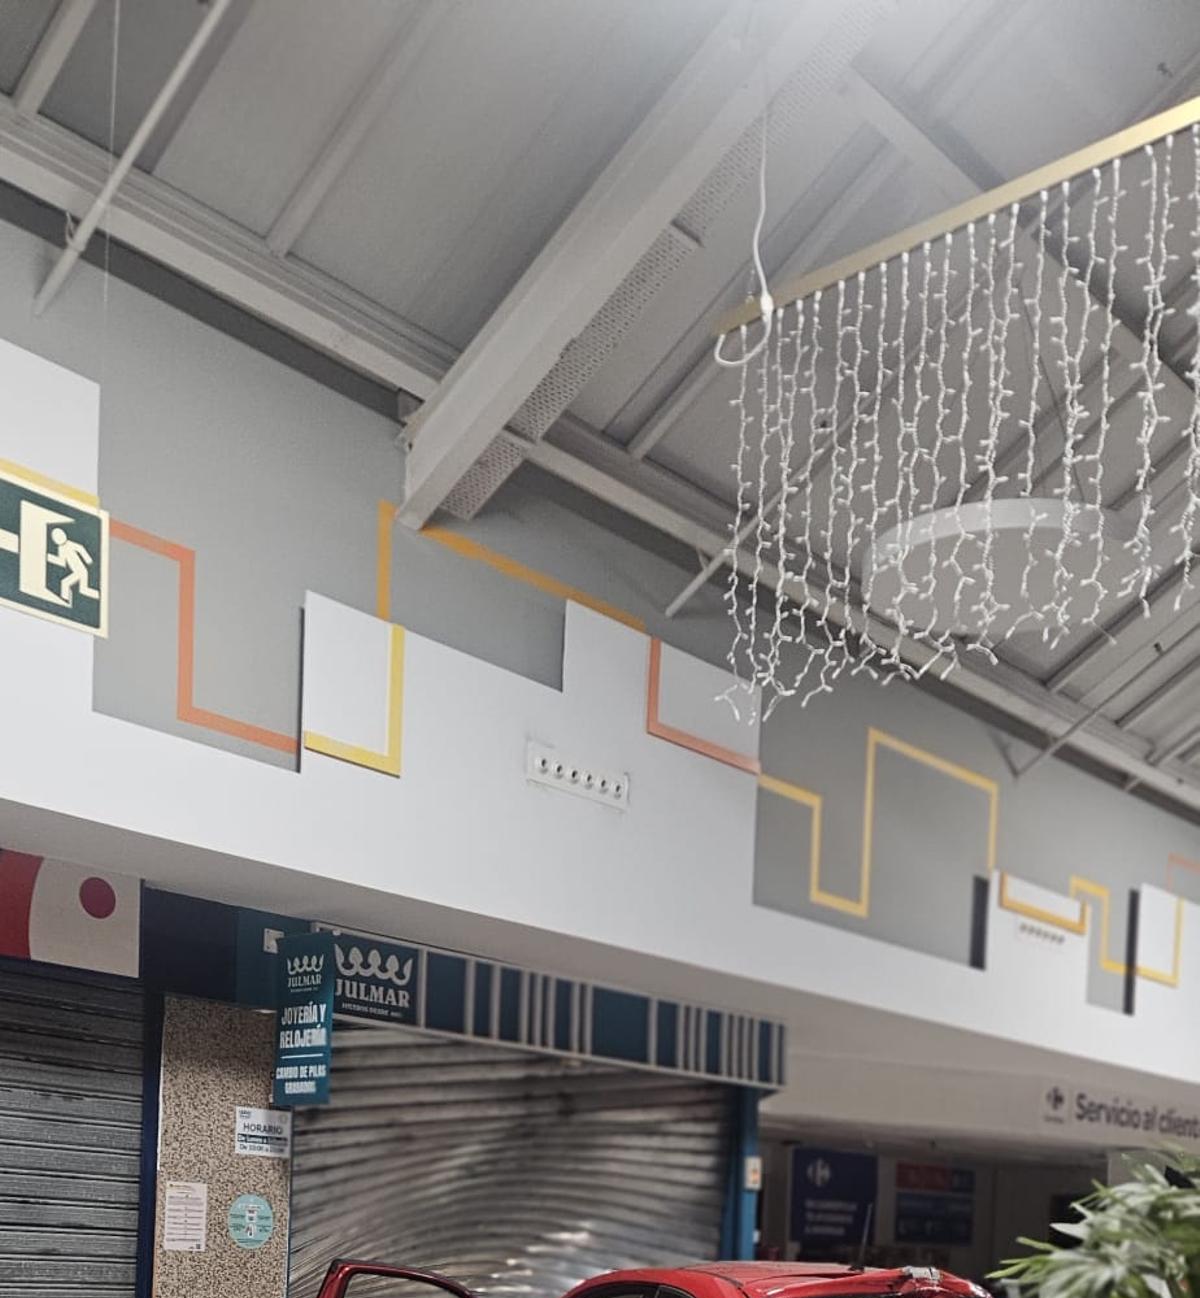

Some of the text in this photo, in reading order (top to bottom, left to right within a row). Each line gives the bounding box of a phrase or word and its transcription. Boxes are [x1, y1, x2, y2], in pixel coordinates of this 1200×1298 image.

[287, 974, 322, 988] JULMAR
[335, 978, 410, 1008] JULMAR
[281, 1001, 327, 1026] JOYERÍA Y
[279, 1024, 327, 1048] RELOJERÍA
[299, 1066, 308, 1078] DE
[309, 1065, 327, 1077] PILAS
[1075, 1093, 1200, 1139] Servicio al client
[243, 1122, 283, 1135] HORARIO
